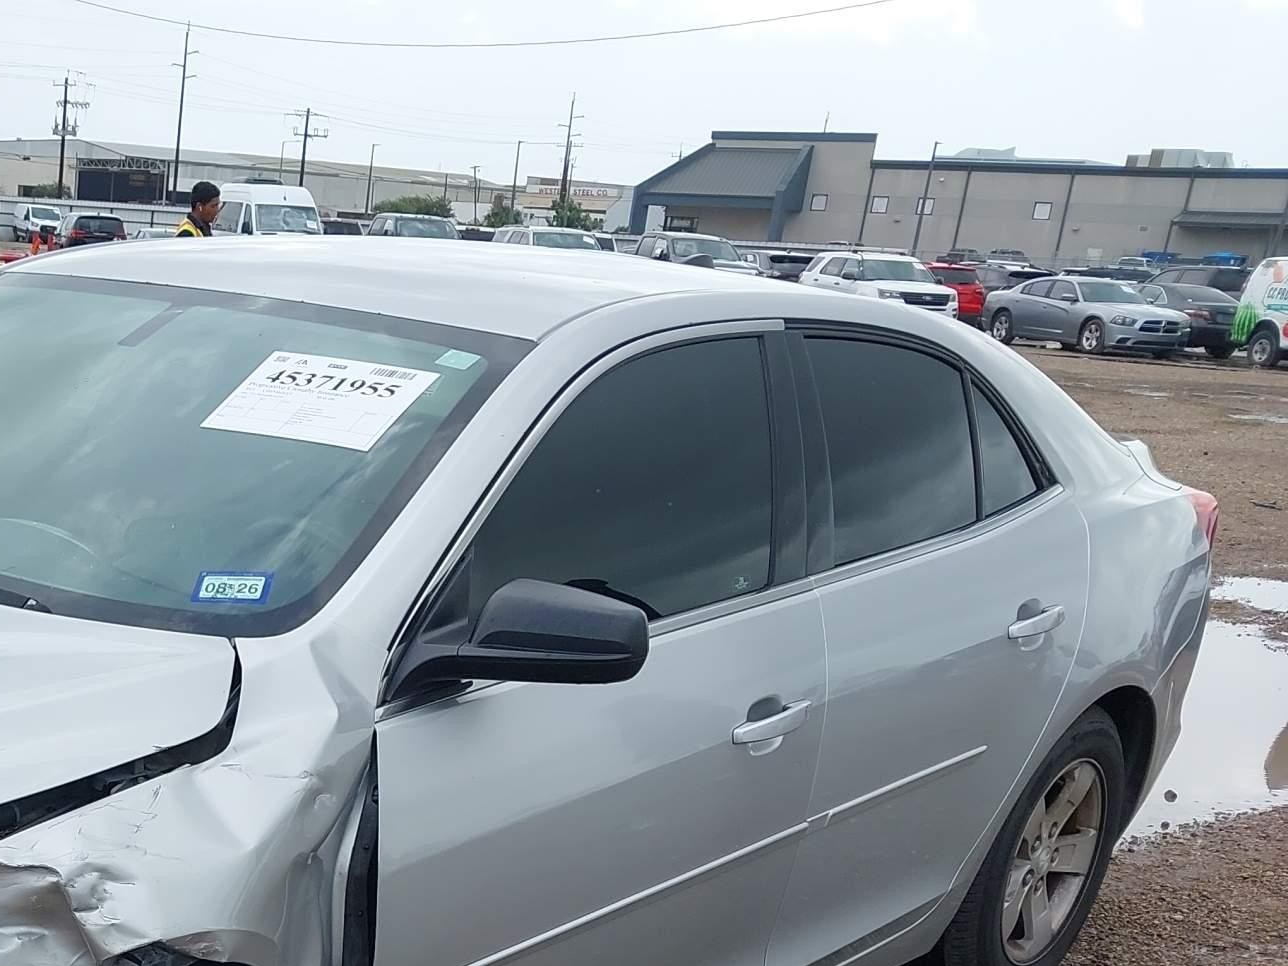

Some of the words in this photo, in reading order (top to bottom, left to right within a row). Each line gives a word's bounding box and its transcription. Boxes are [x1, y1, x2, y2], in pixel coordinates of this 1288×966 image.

[538, 187, 561, 195] WESTE
[573, 189, 594, 197] STEEL
[266, 369, 402, 399] 45371955
